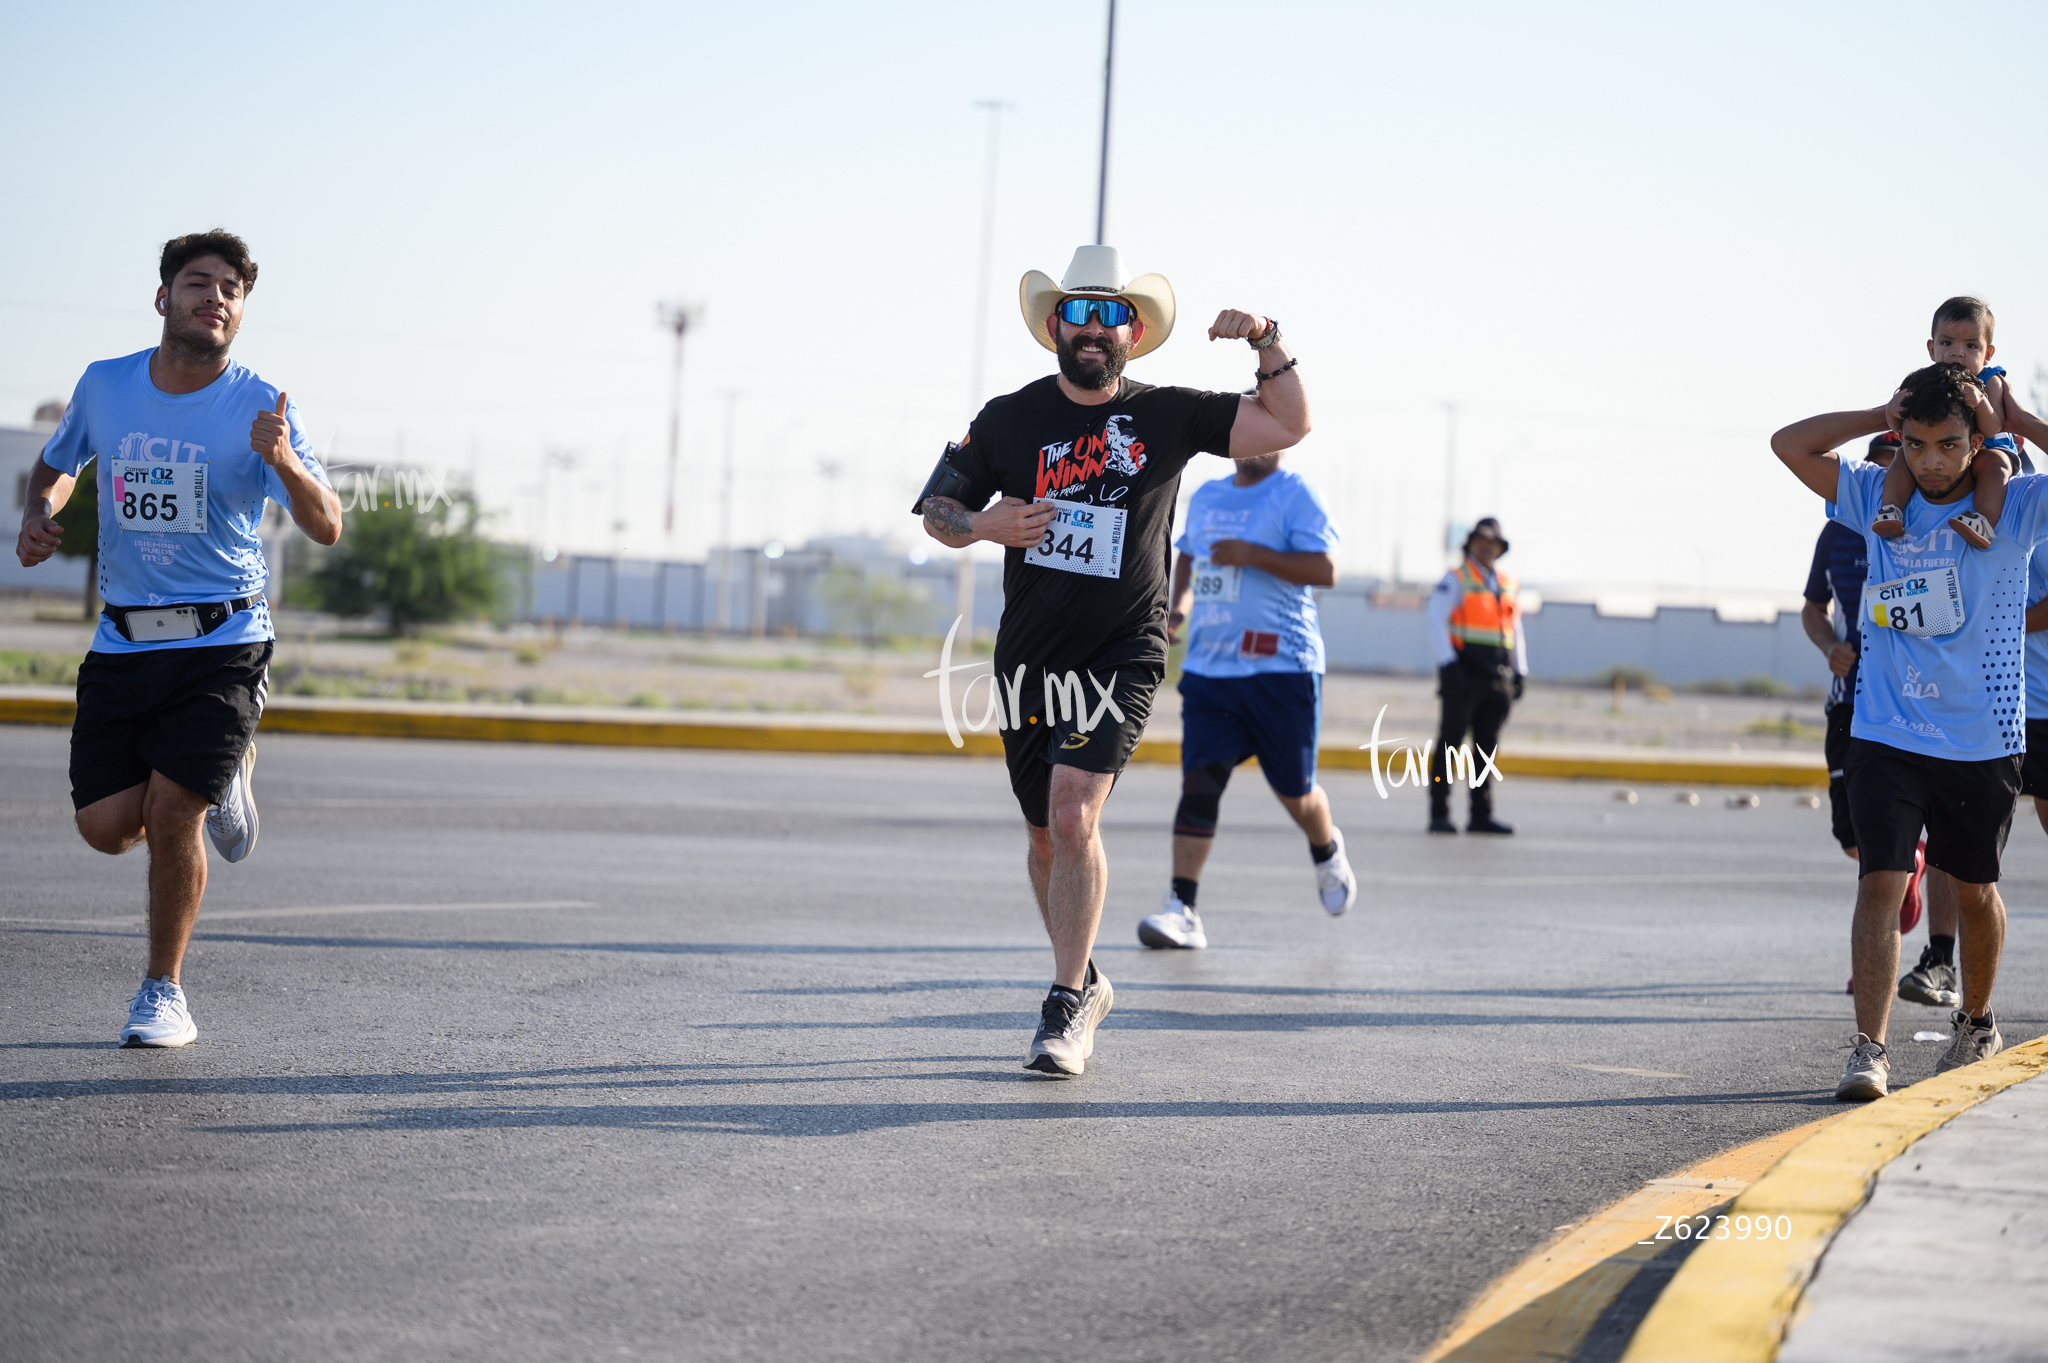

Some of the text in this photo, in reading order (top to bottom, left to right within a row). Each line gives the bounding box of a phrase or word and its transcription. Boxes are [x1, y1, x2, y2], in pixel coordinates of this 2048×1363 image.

[144, 437, 205, 463] CIT
[1042, 441, 1073, 468] THE
[124, 472, 149, 483] CIT
[195, 470, 204, 498] MEDALLA
[123, 491, 178, 521] 865
[1053, 511, 1071, 523] IT
[1112, 516, 1123, 544] MEDALLA
[141, 547, 175, 555] PUEDE
[1038, 529, 1094, 564] 344
[1910, 559, 1921, 568] LA
[1880, 587, 1904, 600] CIT
[1890, 602, 1925, 630] 81
